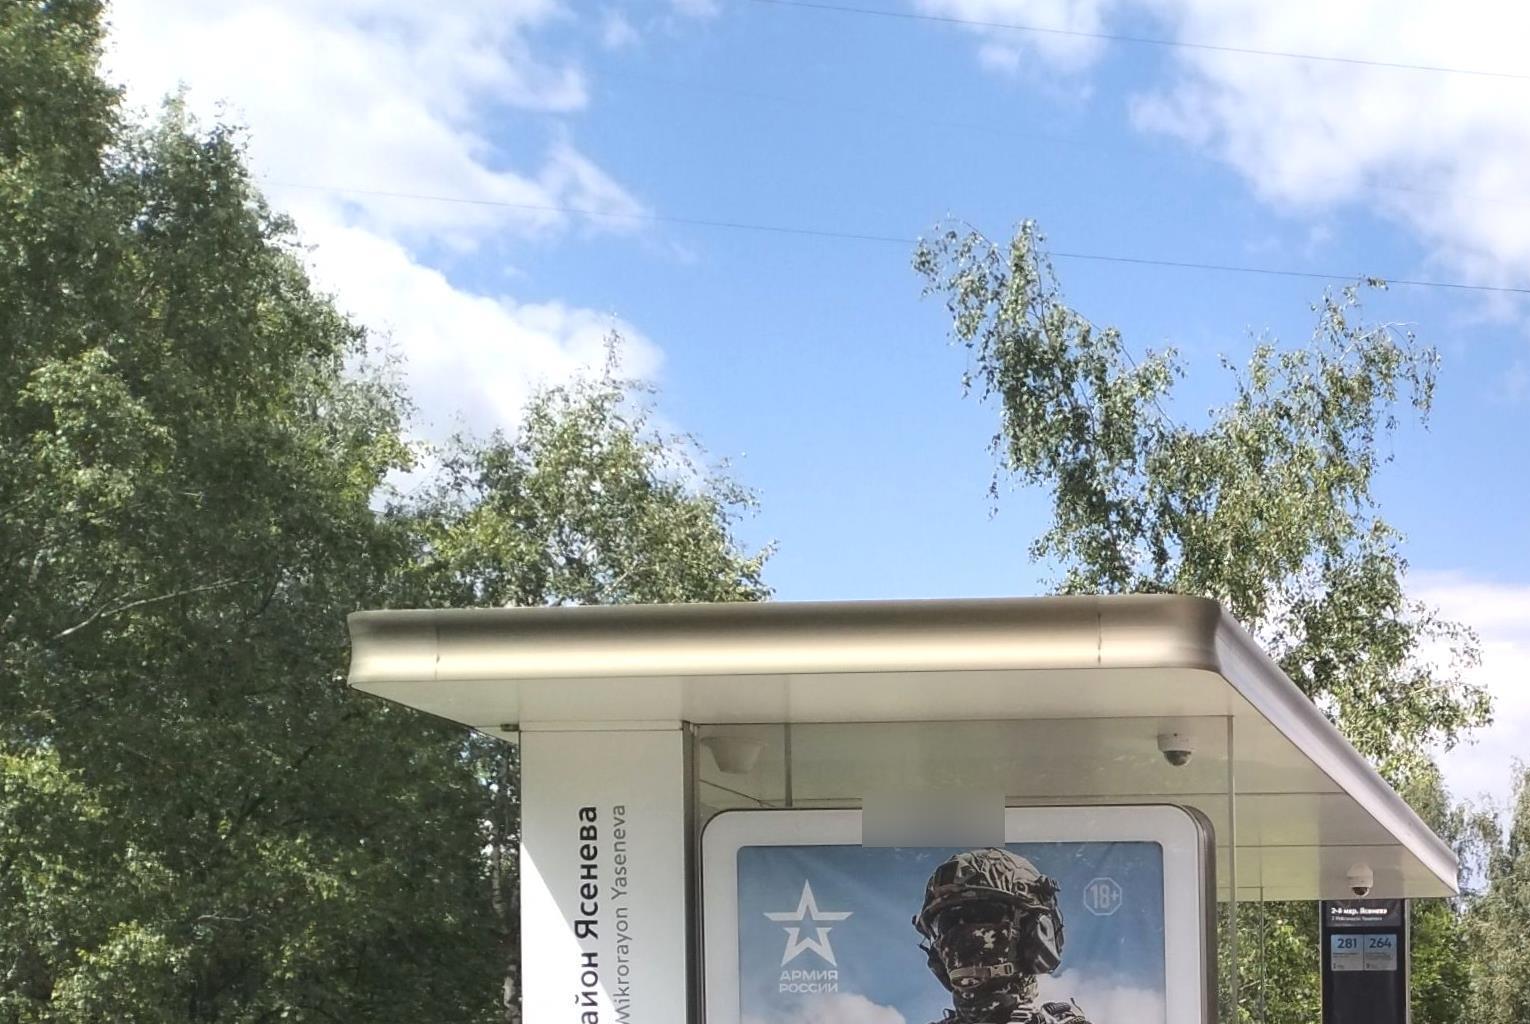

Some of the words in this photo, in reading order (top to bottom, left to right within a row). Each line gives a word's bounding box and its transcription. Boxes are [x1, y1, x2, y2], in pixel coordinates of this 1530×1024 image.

[611, 805, 628, 900] Yaseneva
[574, 806, 599, 940] Ясенева
[1090, 884, 1119, 909] 18+
[1337, 937, 1357, 949] 281
[1369, 937, 1391, 949] 264
[780, 970, 838, 981] АРМИЯ
[779, 983, 838, 993] РОССИИ
